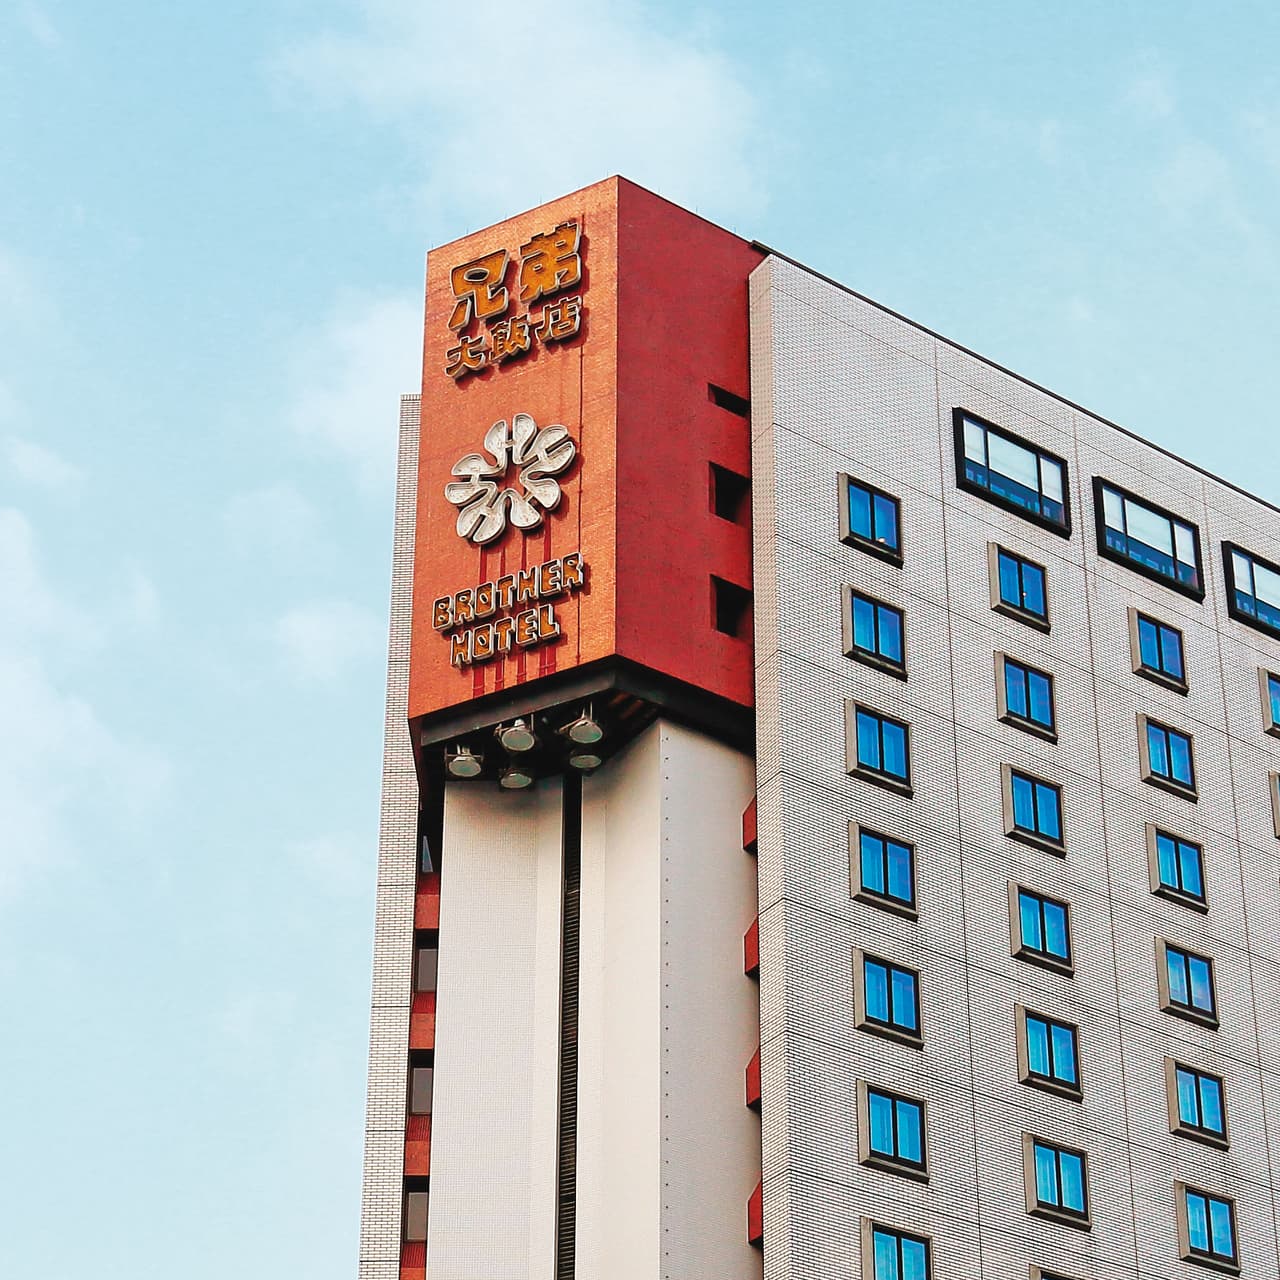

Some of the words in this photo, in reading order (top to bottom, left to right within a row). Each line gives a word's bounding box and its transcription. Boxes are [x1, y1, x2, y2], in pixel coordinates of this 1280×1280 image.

[449, 221, 582, 330] 兄弟
[445, 296, 582, 381] 大飯店
[432, 551, 585, 633] BROTHER
[451, 605, 561, 668] HOTEL
